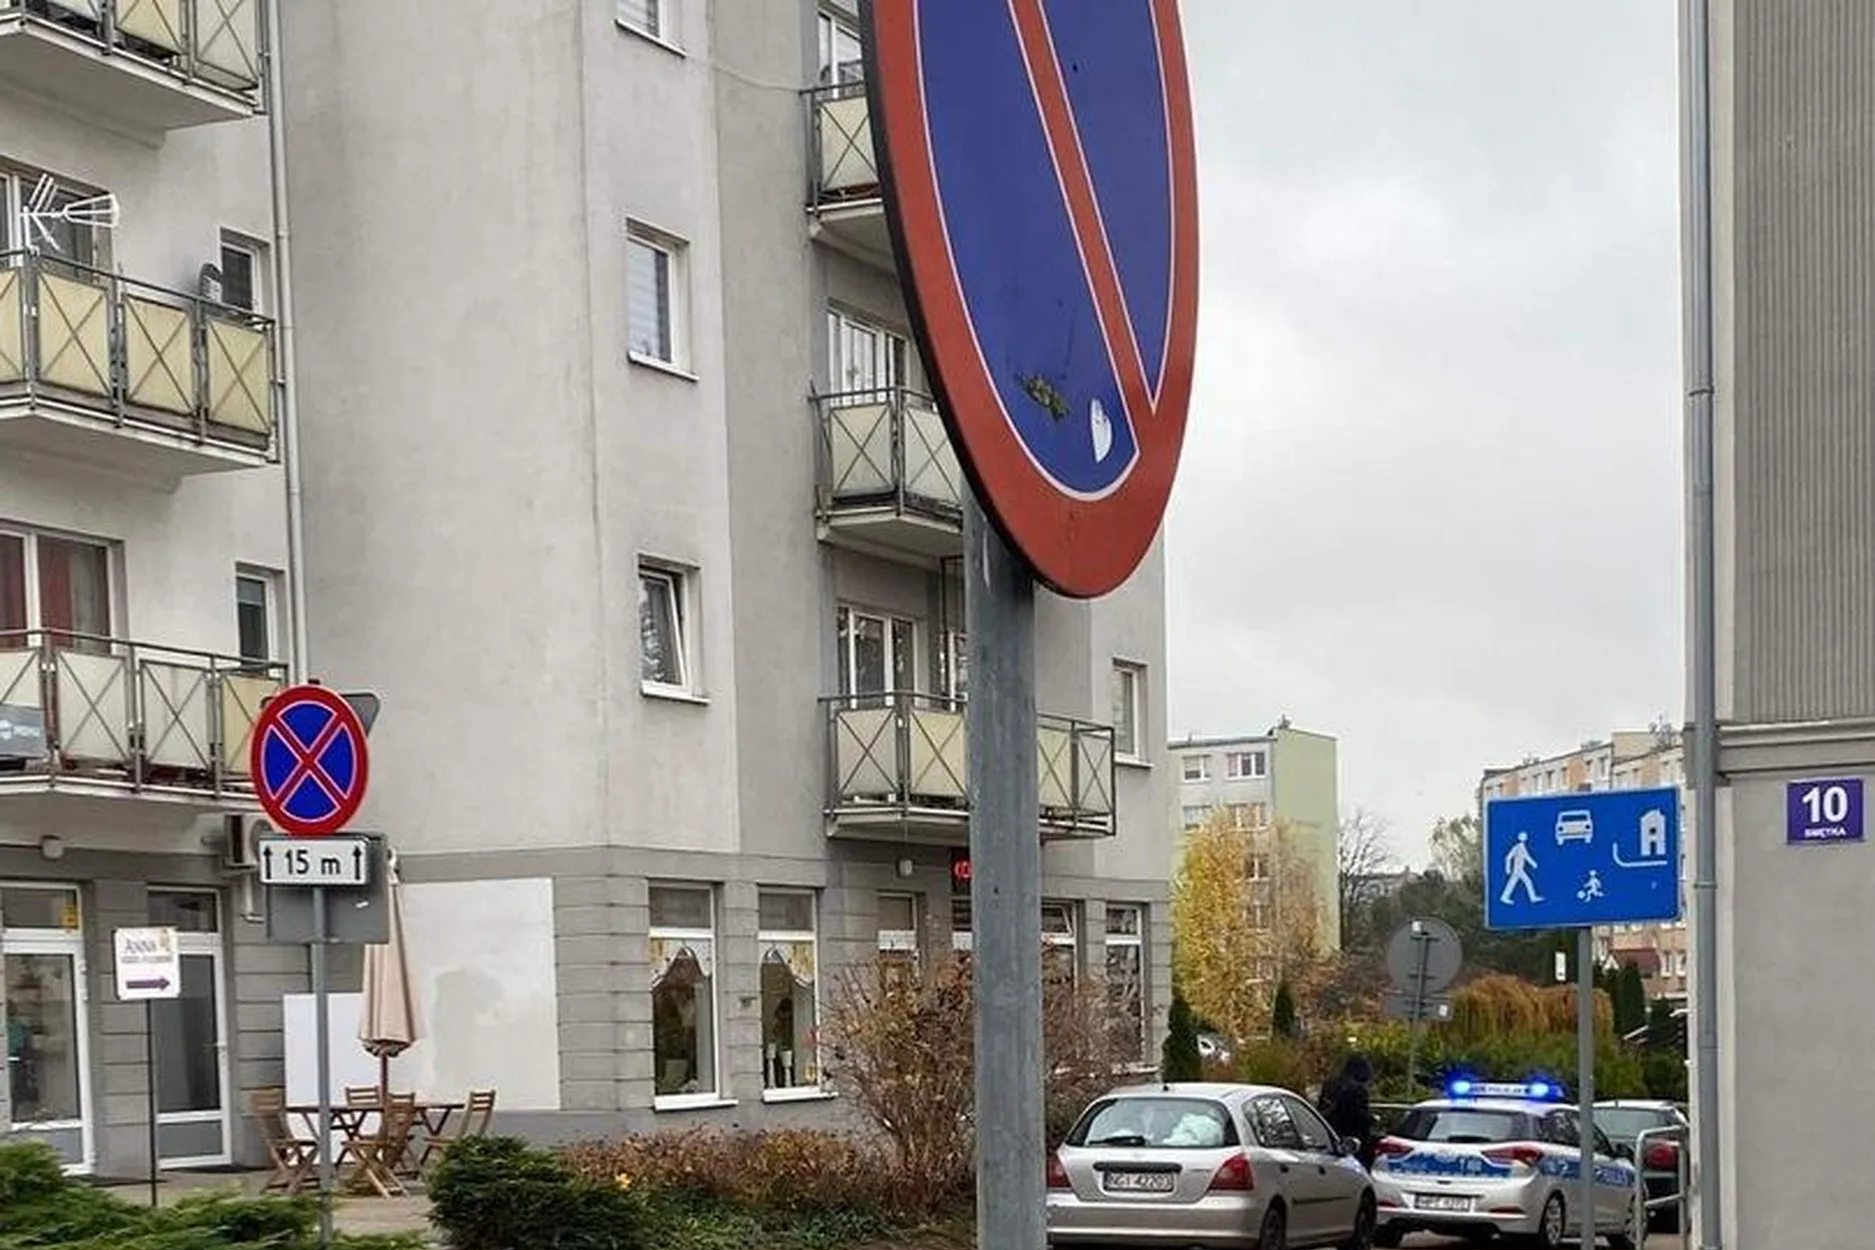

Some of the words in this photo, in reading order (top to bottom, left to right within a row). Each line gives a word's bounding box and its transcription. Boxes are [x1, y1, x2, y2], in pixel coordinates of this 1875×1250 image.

[1803, 786, 1848, 823] 10
[286, 849, 309, 875] 15
[321, 857, 341, 875] m
